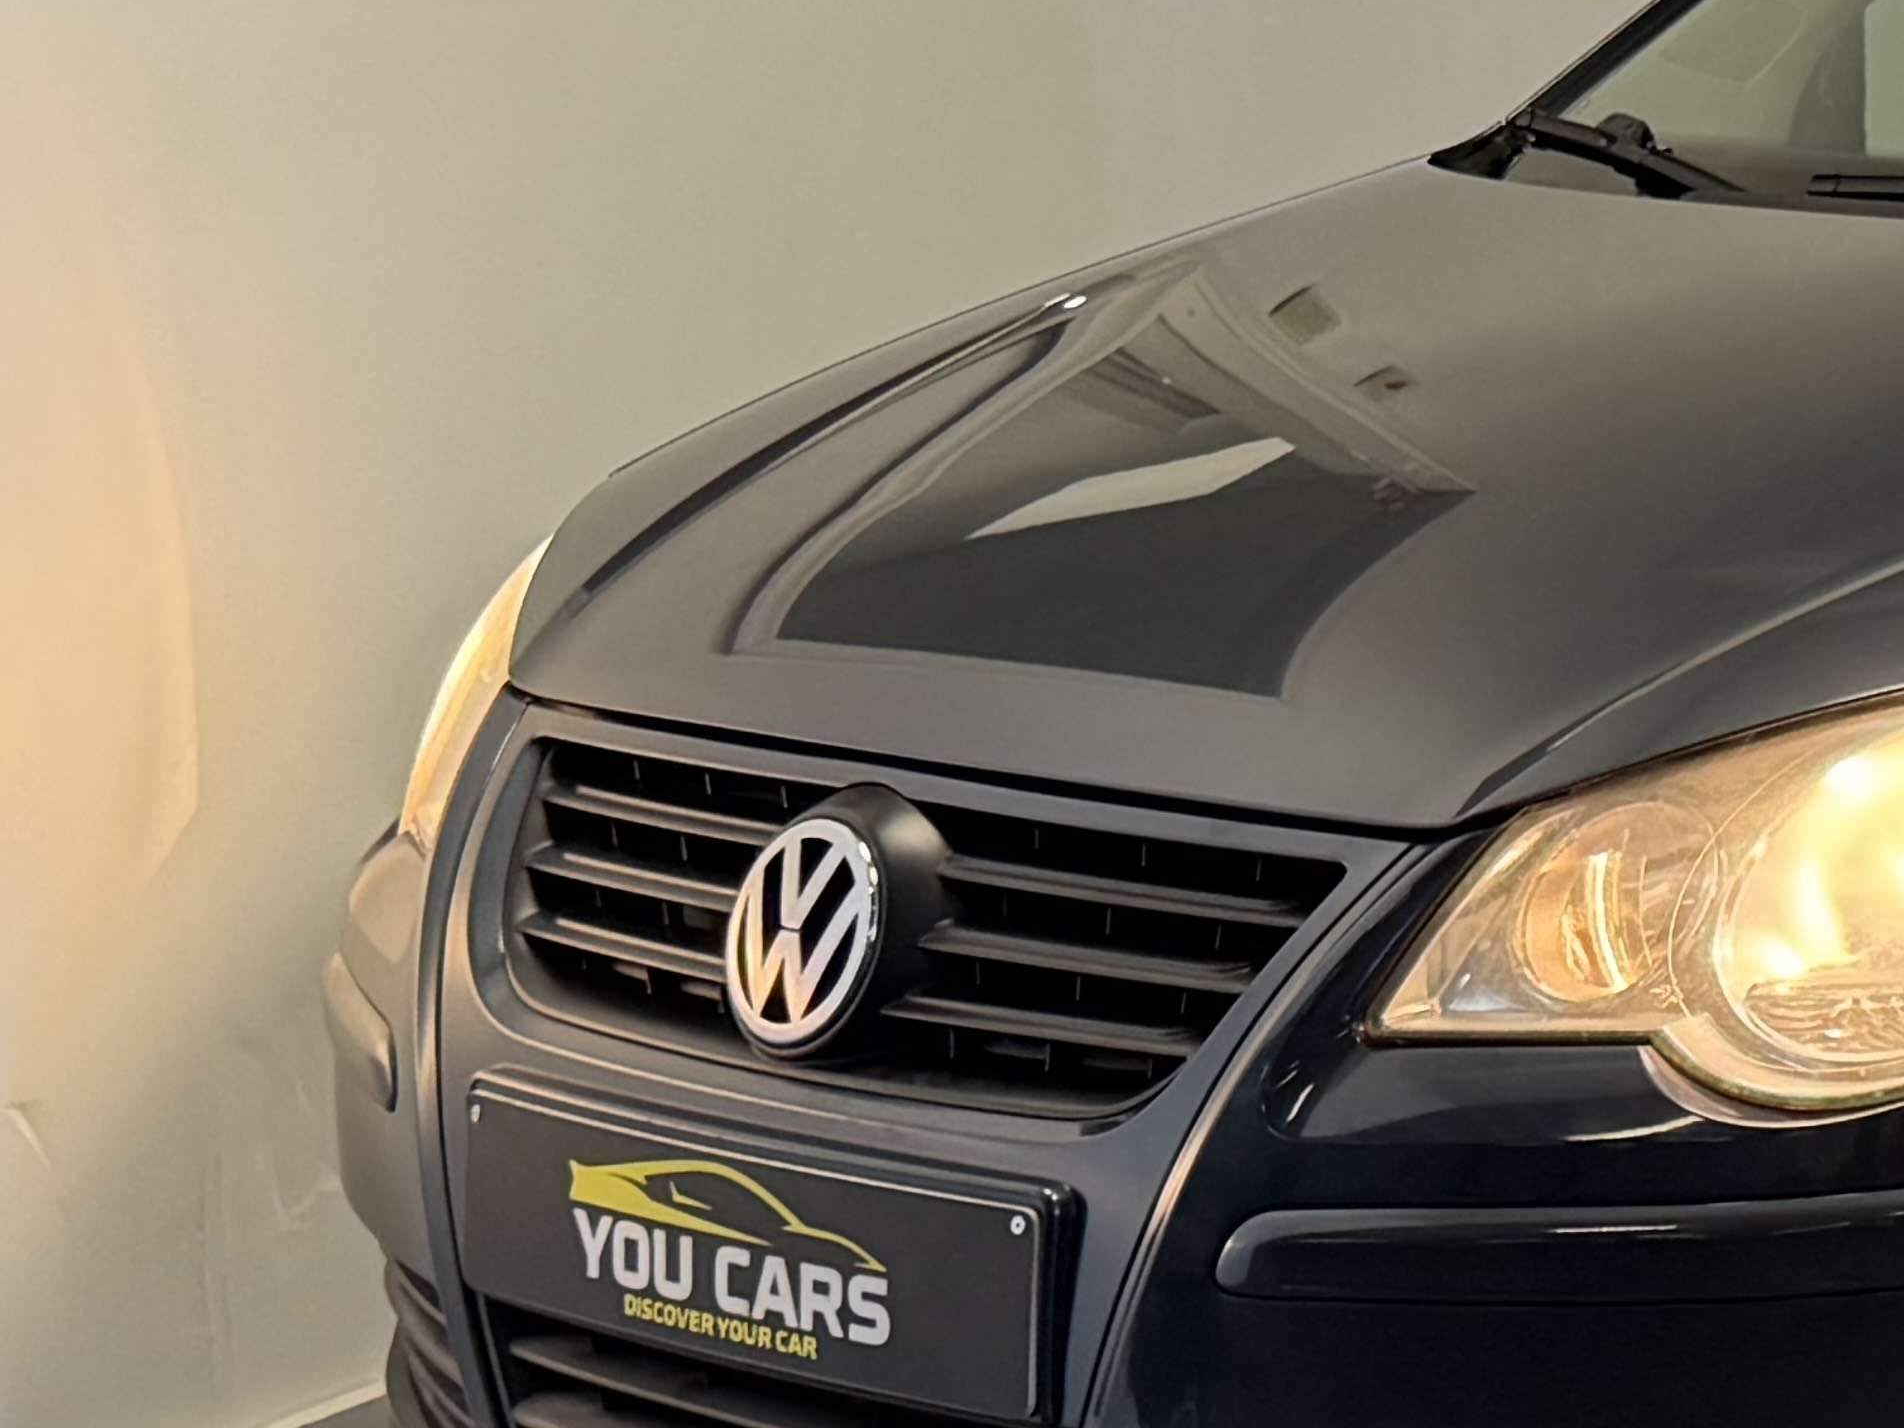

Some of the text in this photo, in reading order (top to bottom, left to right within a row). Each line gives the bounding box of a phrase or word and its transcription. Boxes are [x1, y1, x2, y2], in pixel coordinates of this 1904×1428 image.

[573, 1207, 891, 1347] YOU CARS
[623, 1293, 819, 1360] DISCOVER YOUR CAR
